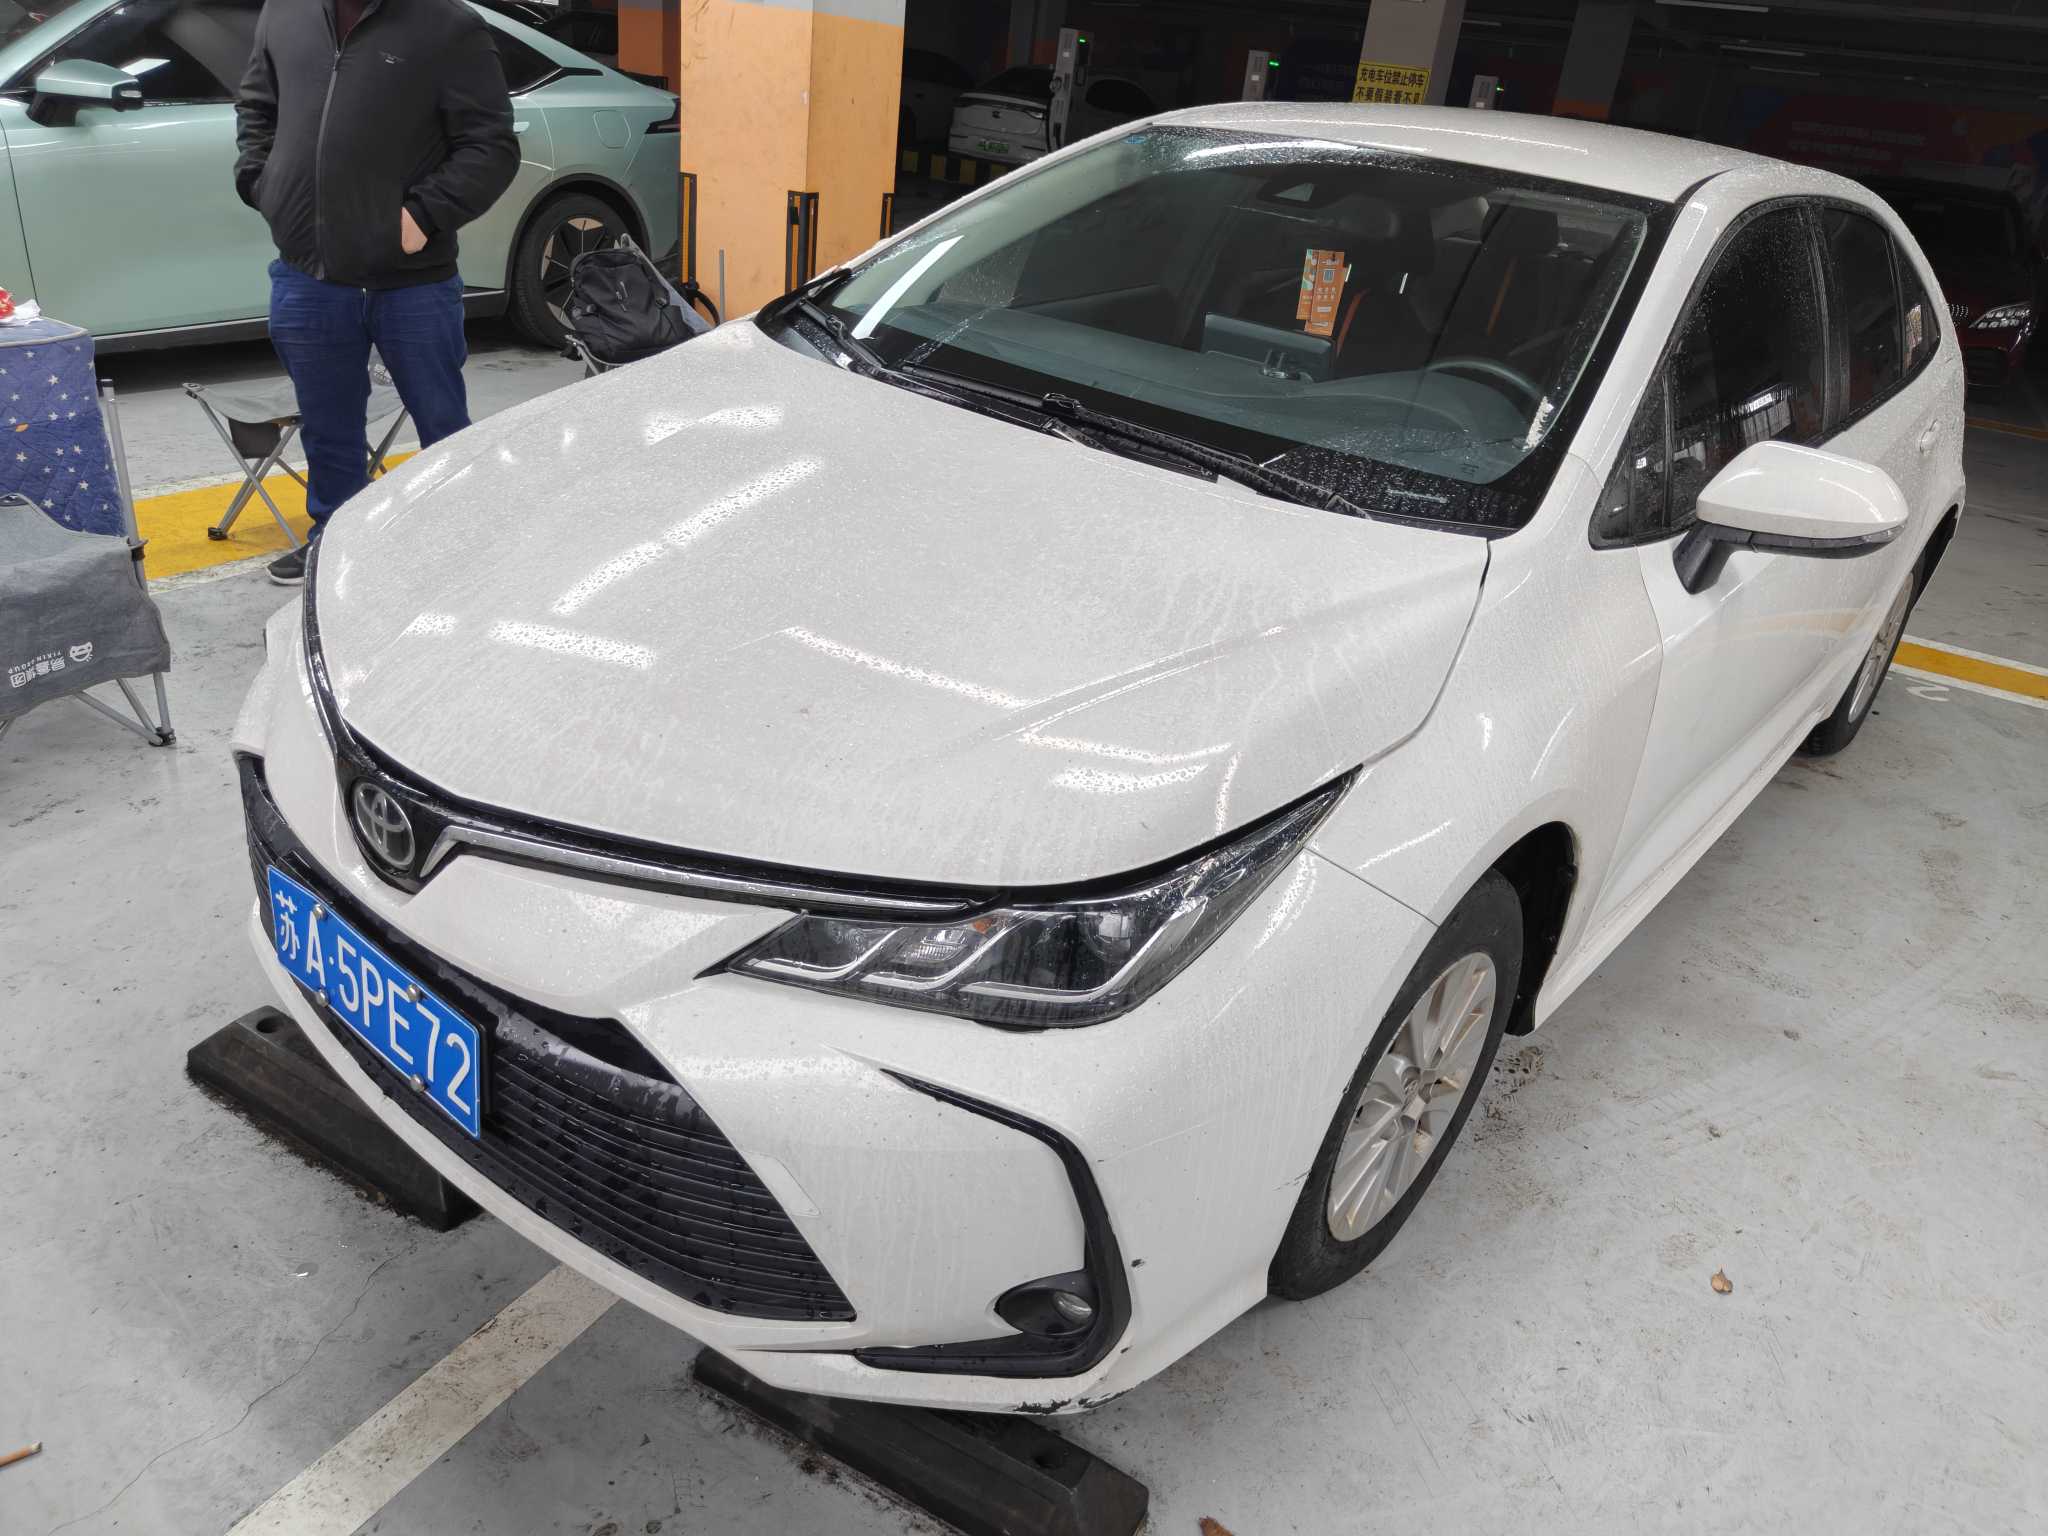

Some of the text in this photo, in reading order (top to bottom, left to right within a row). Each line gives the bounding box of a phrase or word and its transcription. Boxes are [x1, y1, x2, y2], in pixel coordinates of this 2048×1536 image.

[1359, 67, 1425, 88] 充电车位禁止停车
